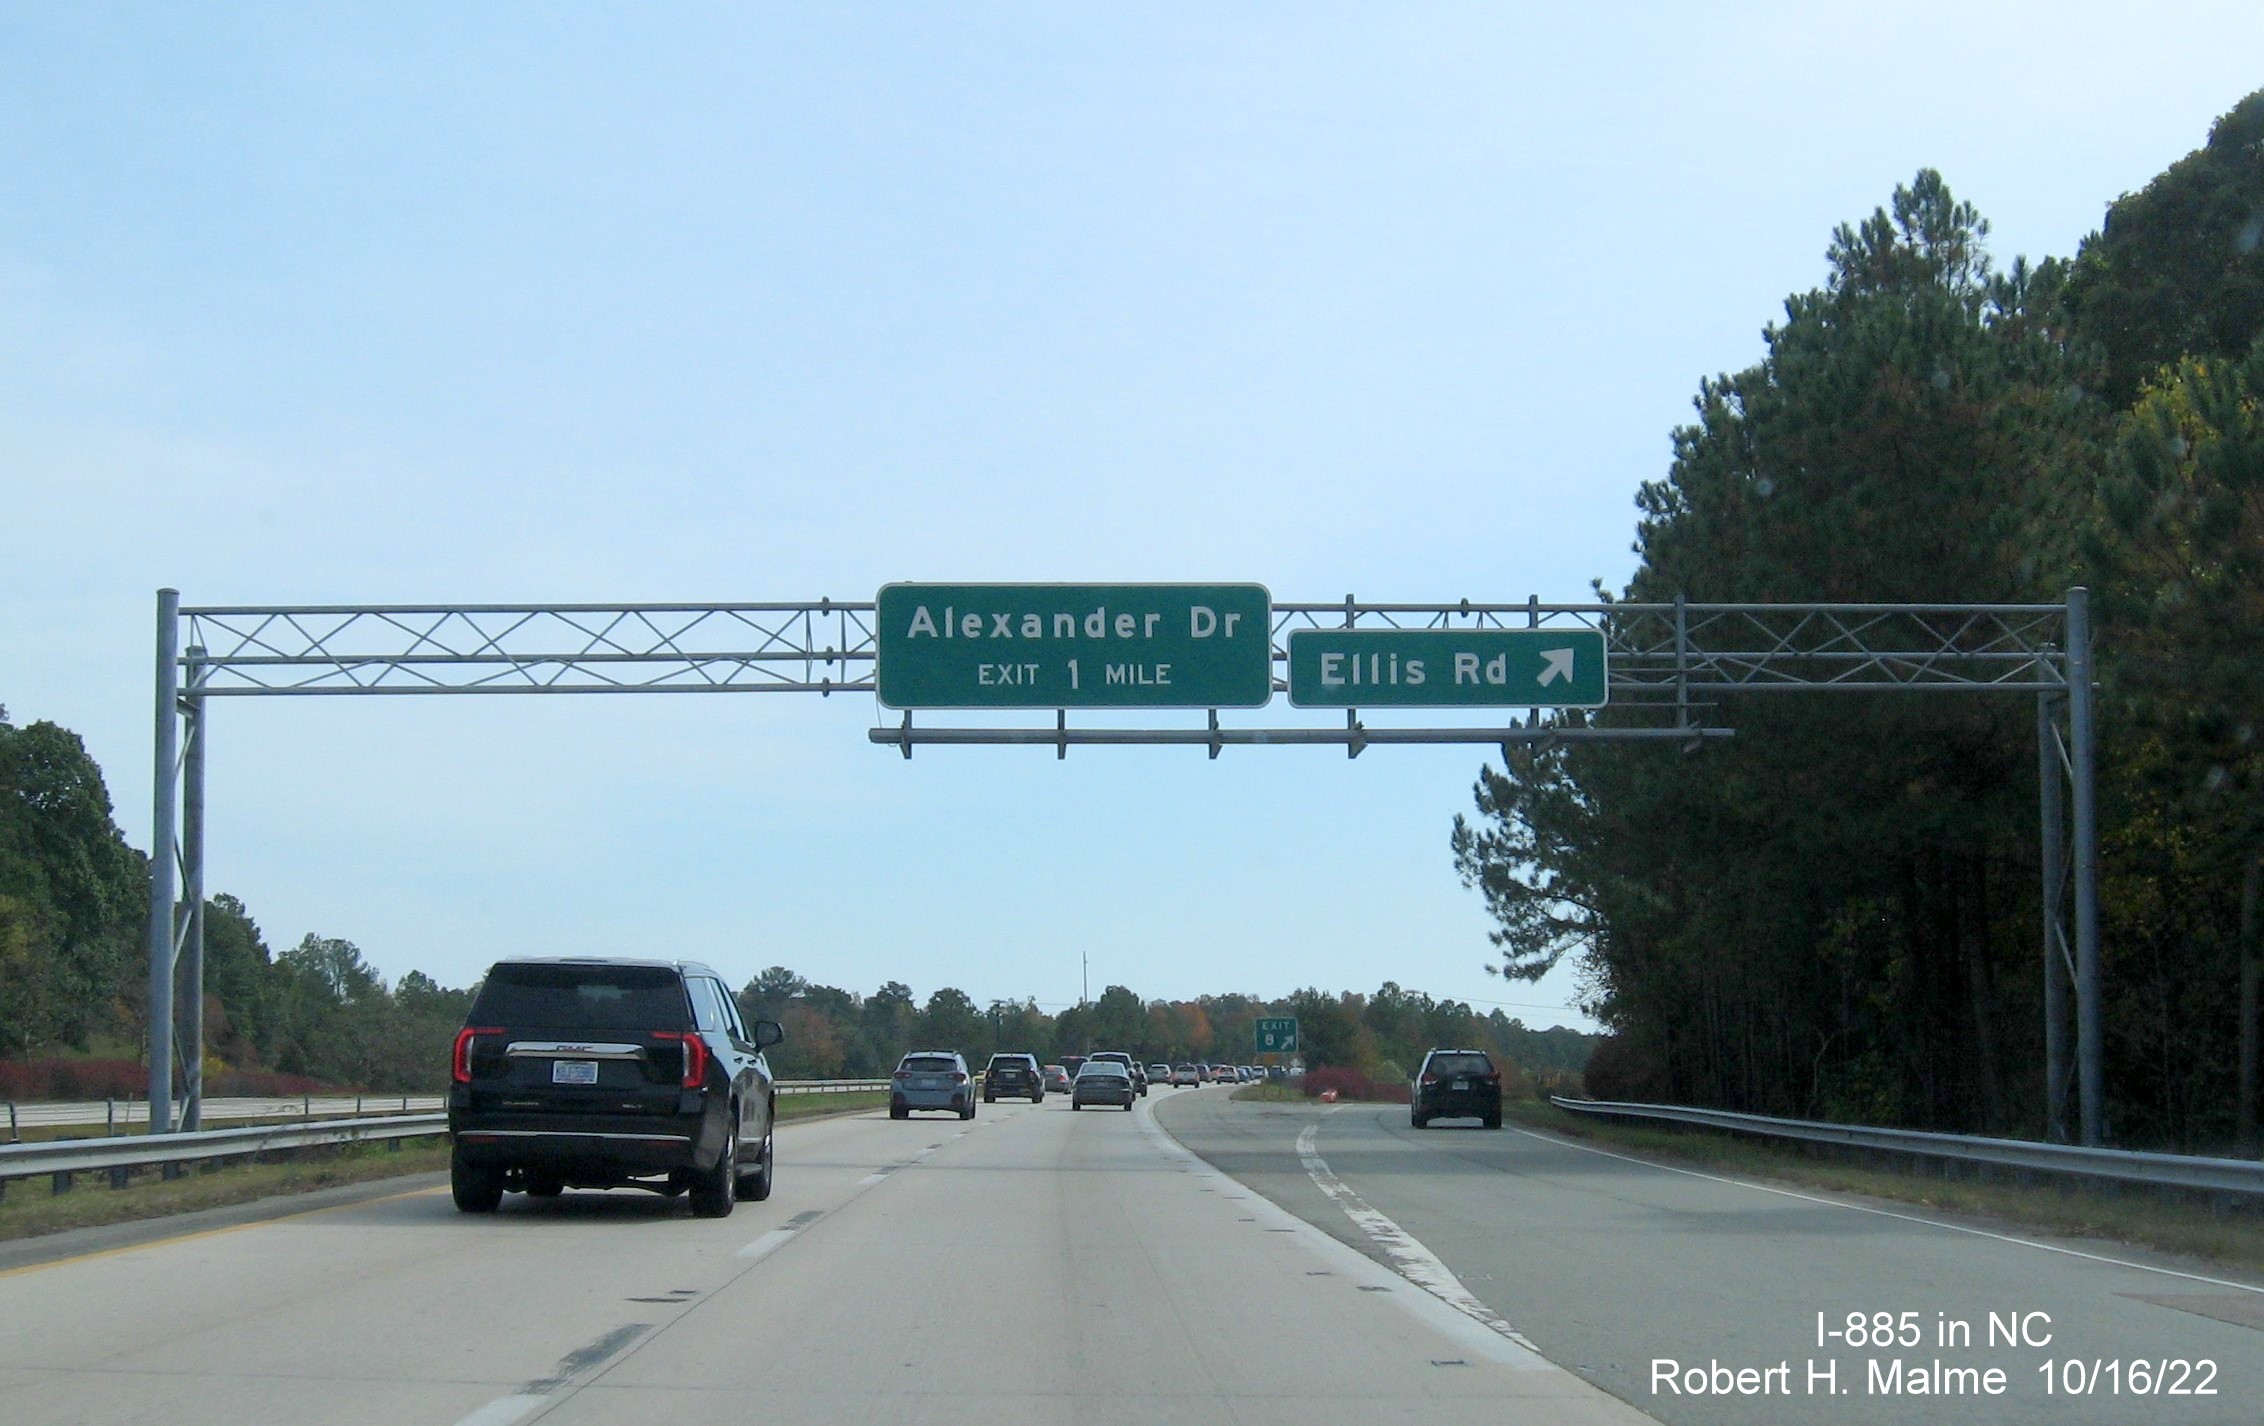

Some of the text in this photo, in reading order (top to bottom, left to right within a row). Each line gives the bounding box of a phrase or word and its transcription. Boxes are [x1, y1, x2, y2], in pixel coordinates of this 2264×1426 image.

[907, 606, 1241, 638] Alexander Dr
[979, 659, 1171, 689] EXIT 1 MILE
[1321, 652, 1506, 685] Ellis Rd
[1262, 1021, 1290, 1031] EXIT
[1265, 1034, 1275, 1046] 8
